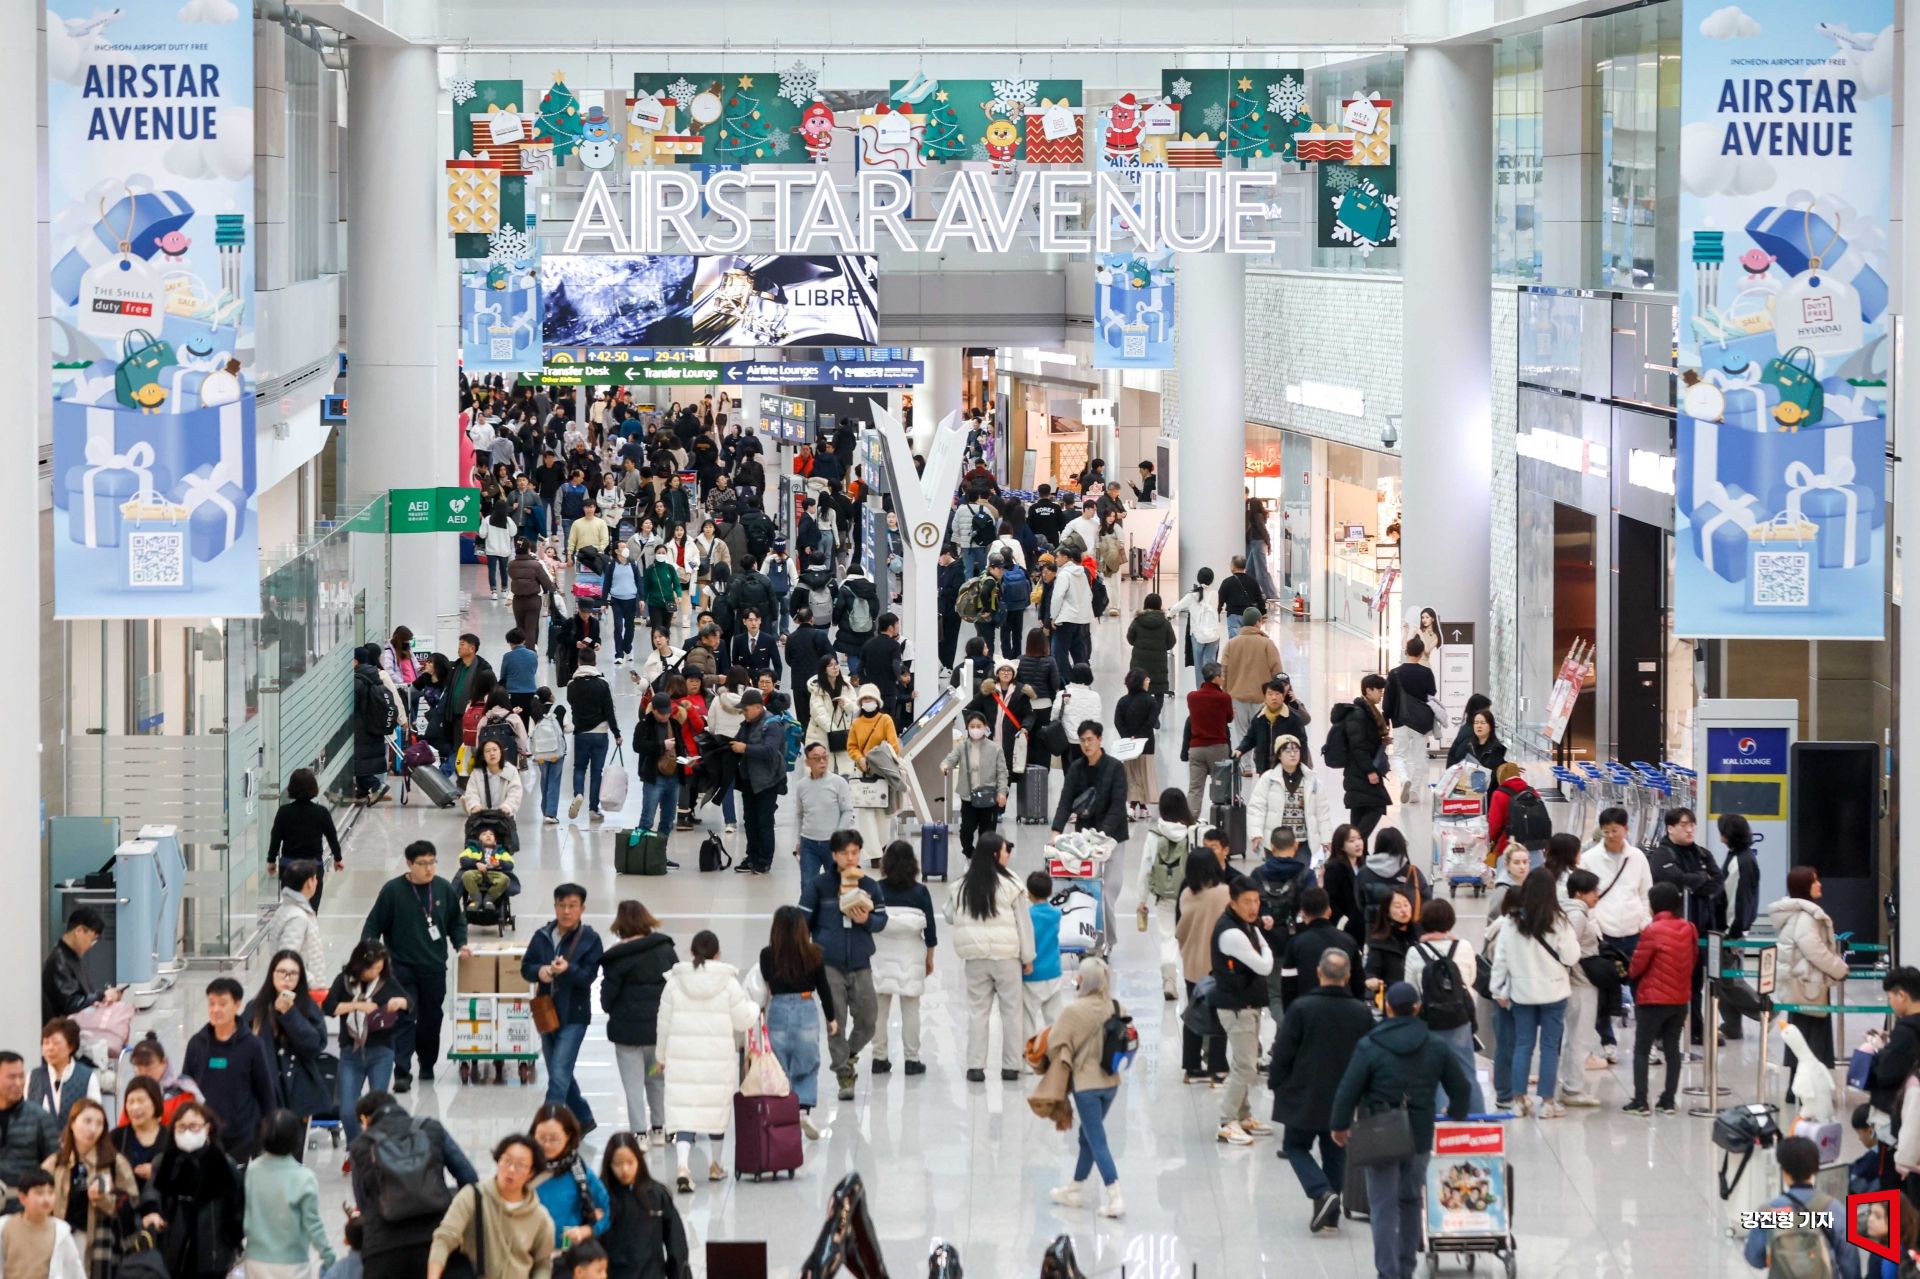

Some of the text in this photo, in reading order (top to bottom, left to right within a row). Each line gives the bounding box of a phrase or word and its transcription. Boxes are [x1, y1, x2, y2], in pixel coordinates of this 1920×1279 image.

[134, 43, 166, 51] AIRPORT
[168, 43, 189, 51] DUTY
[191, 43, 208, 51] FREE
[1731, 58, 1846, 66] INCHEON AIRPORT DUTY FREE
[82, 63, 220, 99] AIRSTAR
[1717, 78, 1857, 113] AIRSTAR
[87, 106, 217, 141] AVENUE
[1721, 121, 1853, 156] AVENUE
[562, 169, 1278, 254] AIRSTAR AVENUE
[93, 286, 154, 299] THE SHILLA
[795, 289, 860, 306] LIBRE
[95, 300, 150, 314] duty free
[1798, 324, 1842, 336] HYUNDAI
[597, 351, 629, 362] 42-50
[655, 351, 686, 362] 29-41
[542, 366, 610, 376] Transfer Desk
[643, 367, 718, 380] Transfer Lounge
[746, 365, 819, 377] Airline Lounges
[408, 501, 429, 512] AED
[447, 515, 468, 524] AED
